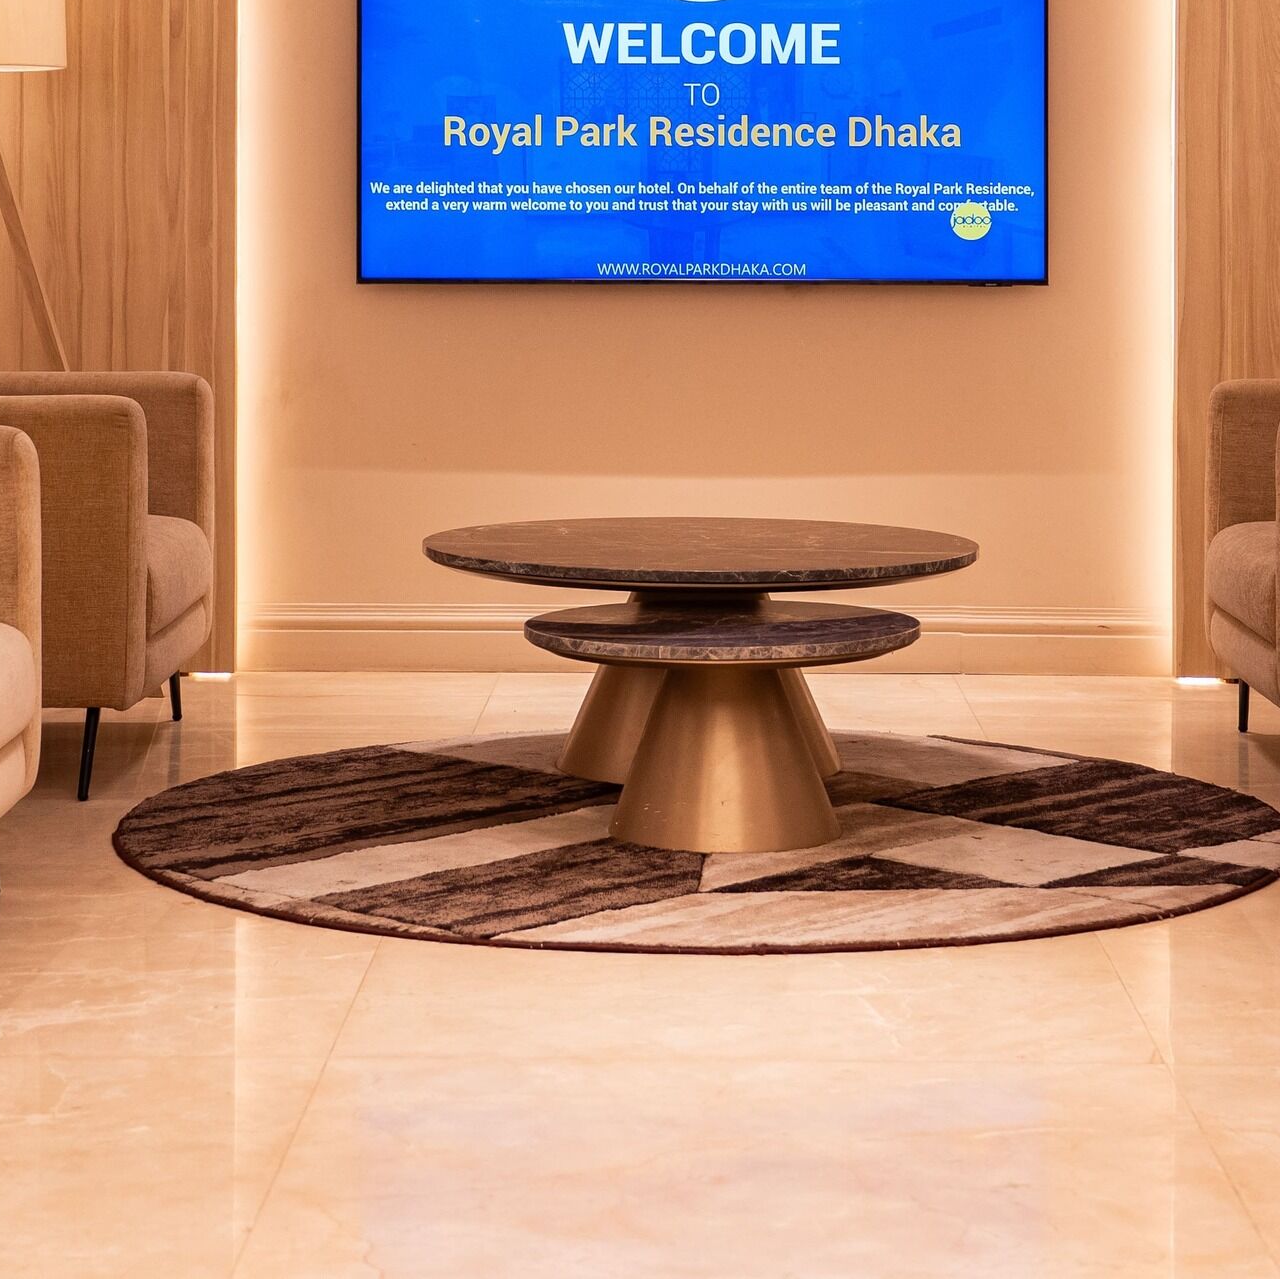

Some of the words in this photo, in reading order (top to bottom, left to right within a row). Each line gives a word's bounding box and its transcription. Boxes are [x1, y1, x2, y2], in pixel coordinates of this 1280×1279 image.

[563, 23, 841, 65] WELCOME
[684, 82, 720, 107] TO
[444, 114, 542, 155] Royal
[556, 114, 638, 147] Park
[649, 114, 836, 147] Residence
[848, 114, 961, 148] Dhaka
[371, 183, 389, 194] We
[393, 185, 412, 194] are
[416, 182, 474, 197] delighted
[478, 182, 503, 194] that
[506, 185, 529, 197] you
[533, 182, 562, 194] have
[566, 182, 611, 194] chosen
[614, 185, 635, 194] our
[639, 182, 673, 194] hotel.
[678, 182, 695, 194] On
[699, 182, 738, 194] behalf
[741, 182, 754, 194] of
[757, 182, 777, 194] the
[781, 182, 817, 194] entire
[820, 184, 852, 194] team
[856, 182, 868, 194] of
[872, 182, 892, 194] the
[895, 182, 930, 198] Royal
[934, 182, 962, 194] Park
[966, 182, 1035, 197] Residence,
[386, 199, 428, 211] extend
[432, 202, 439, 211] a
[443, 202, 469, 214] very
[473, 202, 506, 211] warm
[511, 199, 566, 211] welcome
[570, 200, 582, 211] to
[586, 202, 608, 214] you
[612, 199, 635, 211] and
[639, 200, 668, 211] trust
[672, 199, 697, 211] that
[700, 202, 728, 214] your
[732, 200, 758, 214] stay
[762, 199, 788, 211] with
[793, 202, 807, 211] us
[811, 199, 831, 211] will
[836, 199, 850, 211] be
[854, 199, 908, 214] pleasant
[912, 199, 934, 211] and
[952, 213, 993, 228] jadoo
[597, 263, 806, 276] WWW.ROYALPARKDHAKA.COM
